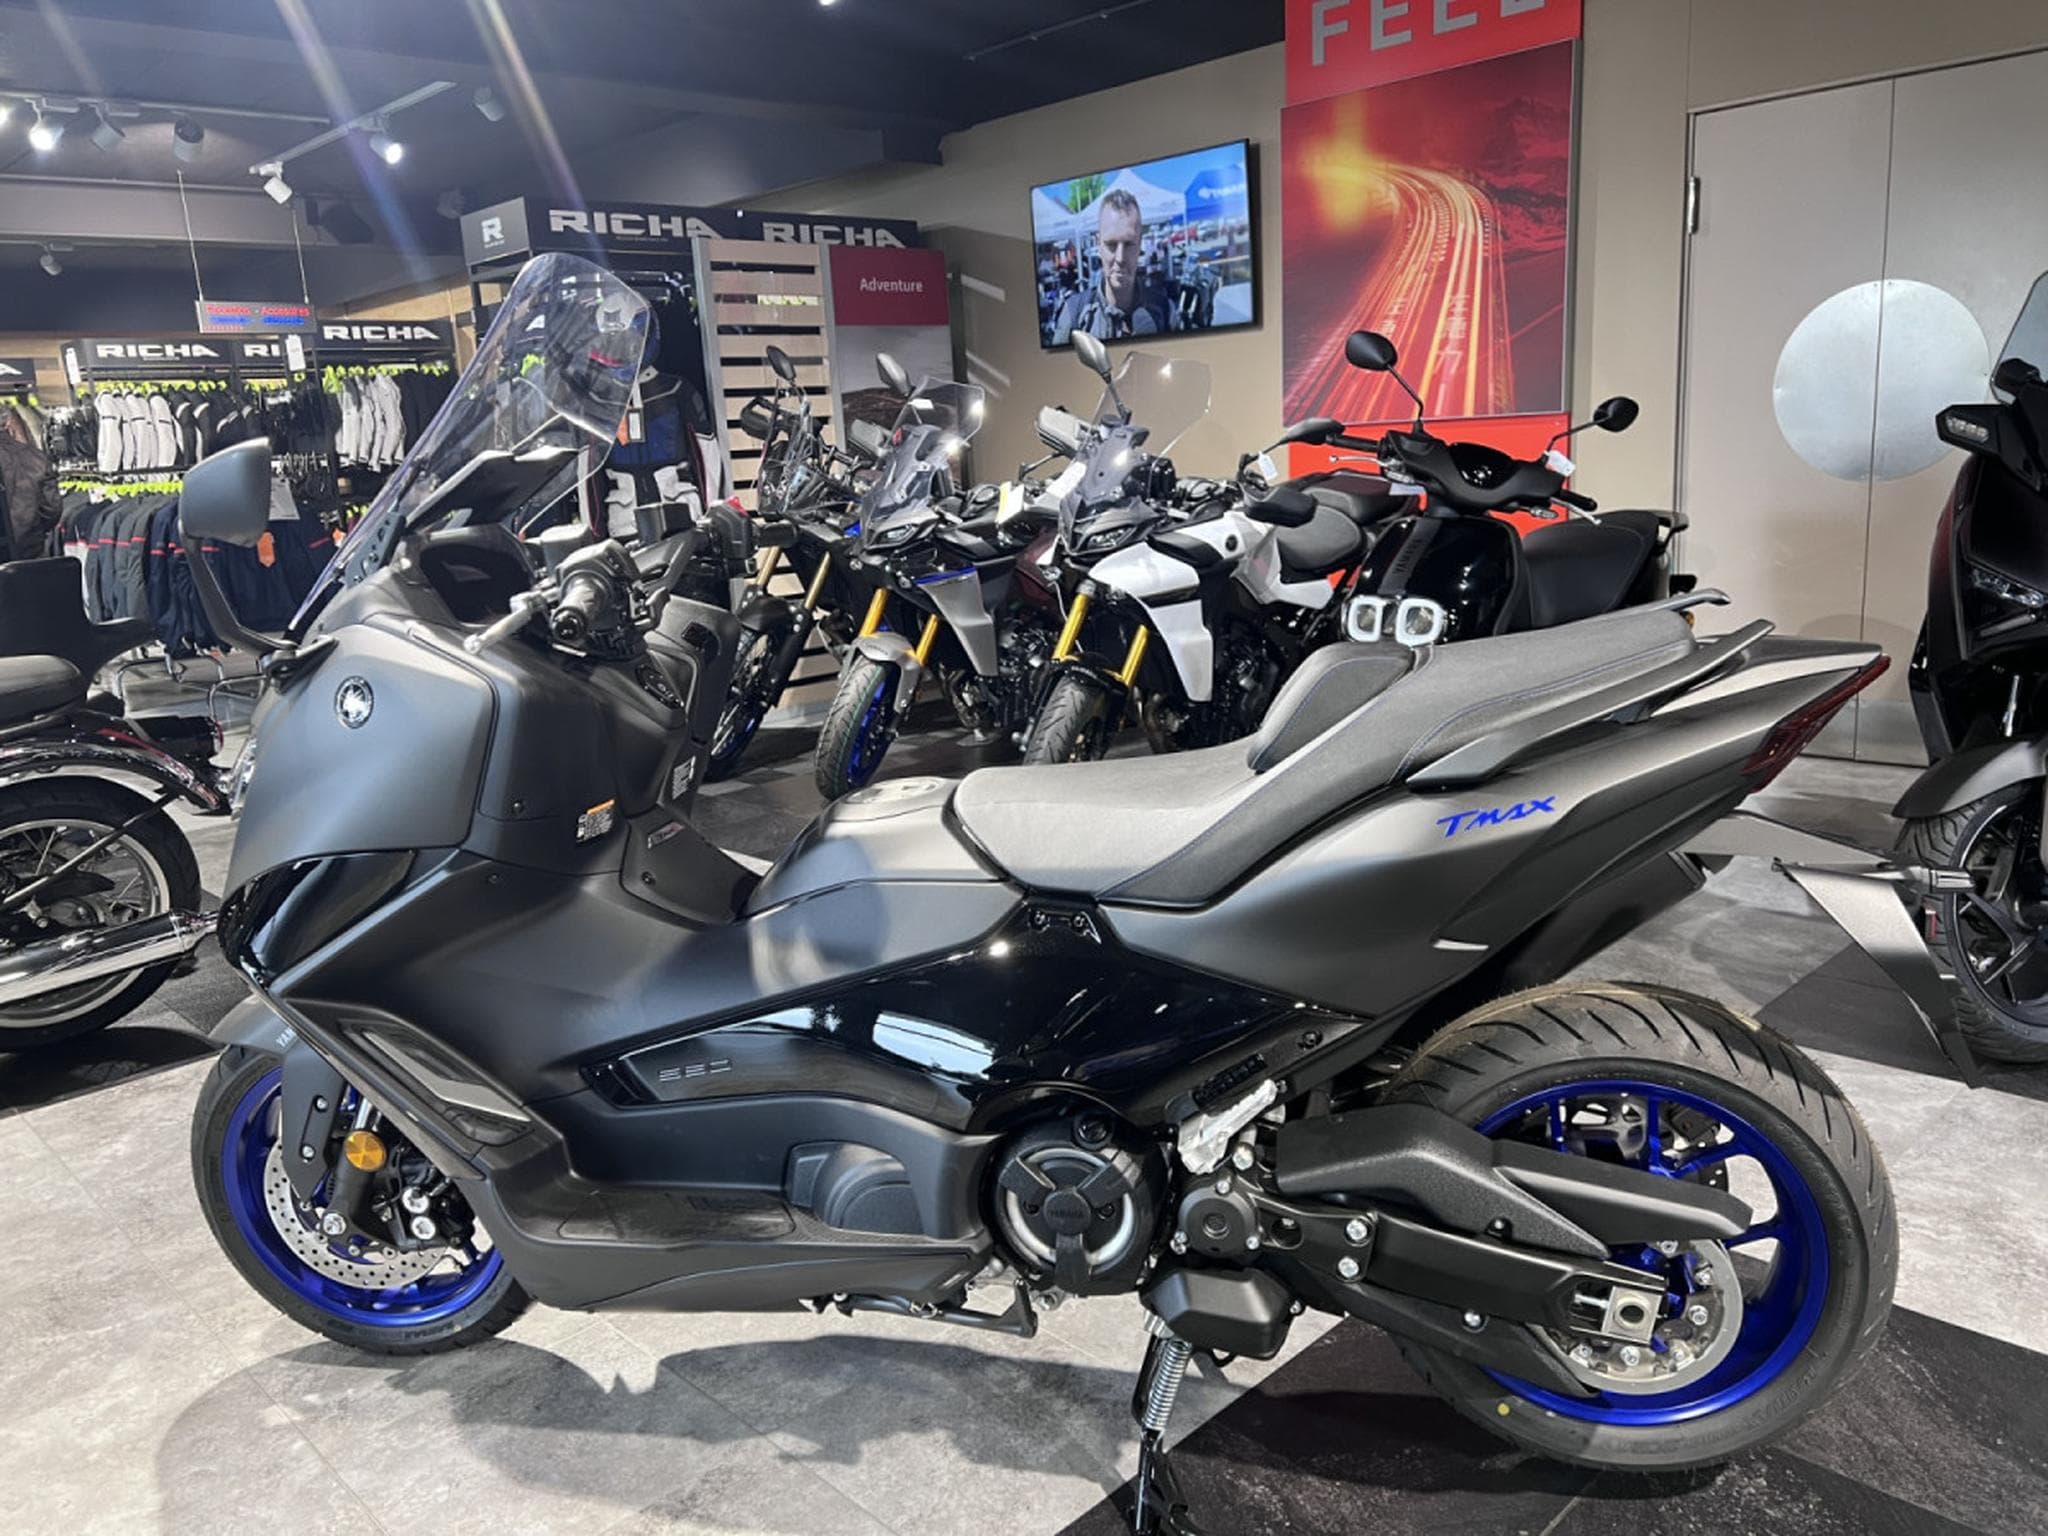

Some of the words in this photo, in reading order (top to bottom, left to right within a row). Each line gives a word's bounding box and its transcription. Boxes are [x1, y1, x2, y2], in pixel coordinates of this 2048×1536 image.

[549, 209, 722, 239] RICHA
[762, 222, 906, 248] RICHA
[860, 278, 923, 292] Adventure
[323, 326, 440, 340] RICHA
[97, 344, 219, 358] RICHA
[1436, 796, 1555, 837] TMAX
